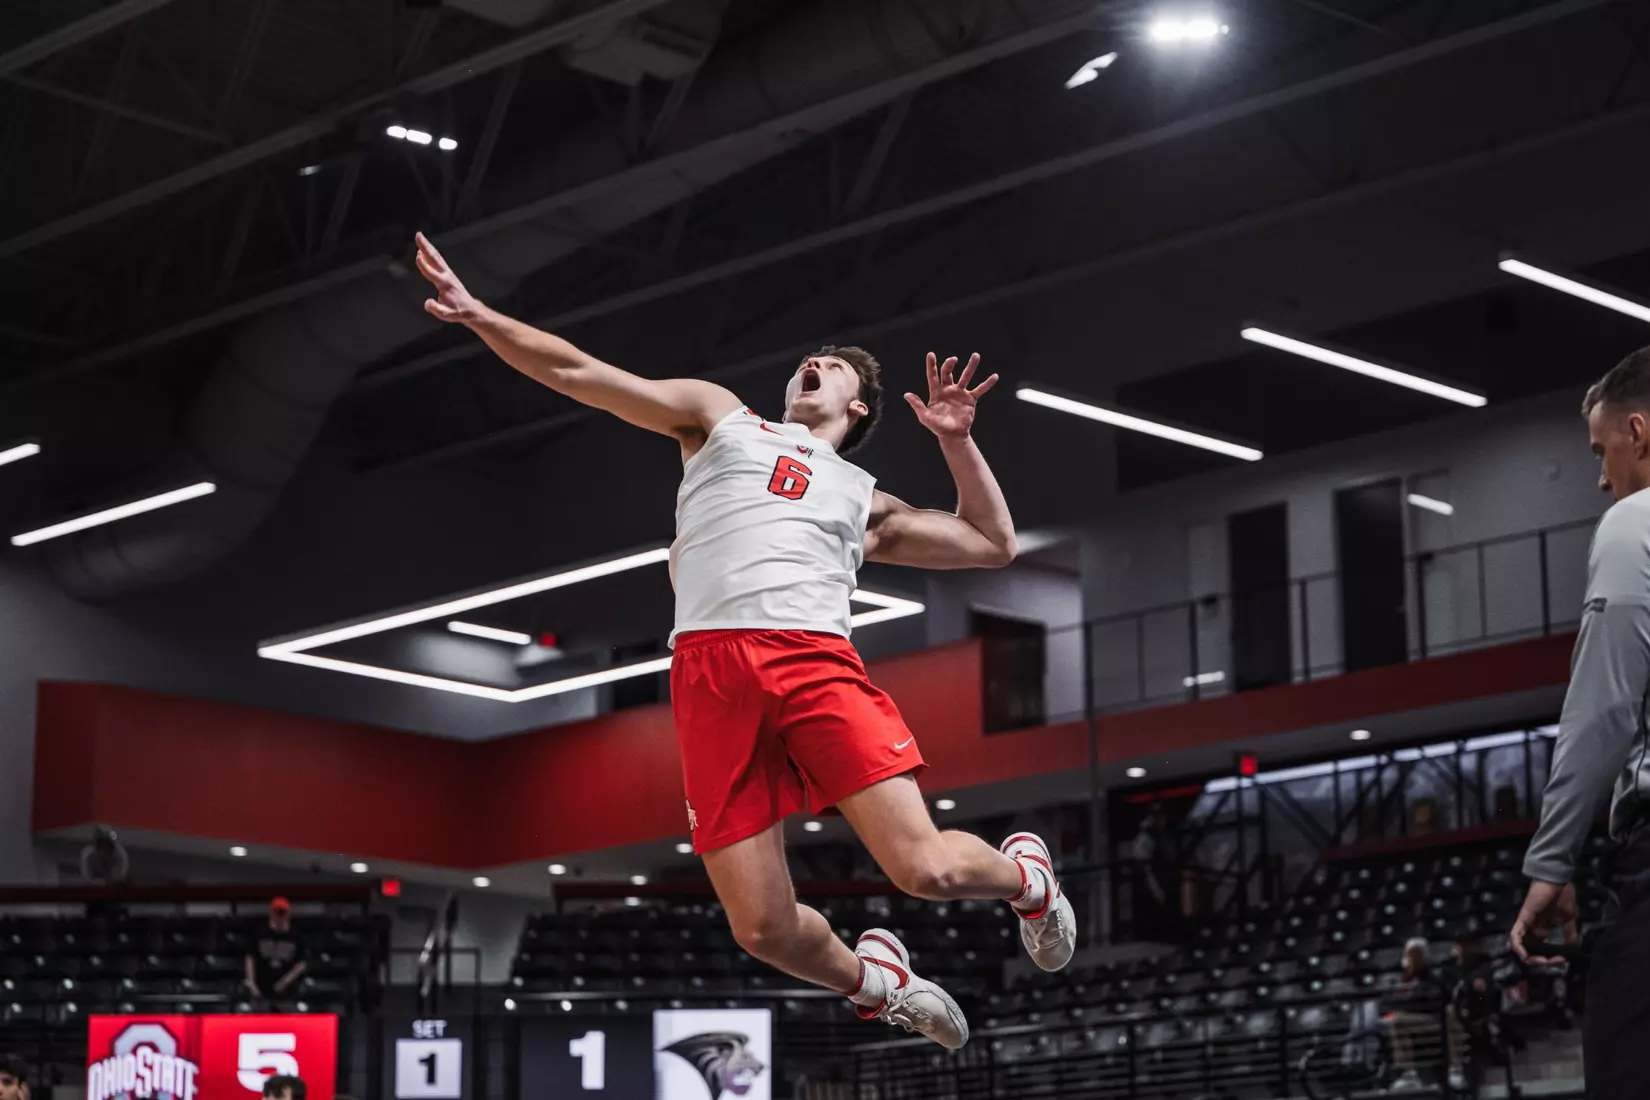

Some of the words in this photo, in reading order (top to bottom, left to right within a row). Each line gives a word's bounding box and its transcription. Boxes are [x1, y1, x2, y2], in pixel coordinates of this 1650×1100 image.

[767, 455, 812, 500] 6
[412, 1019, 447, 1038] SET
[237, 1032, 299, 1093] 5
[419, 1052, 437, 1085] 1
[569, 1030, 605, 1090] 1
